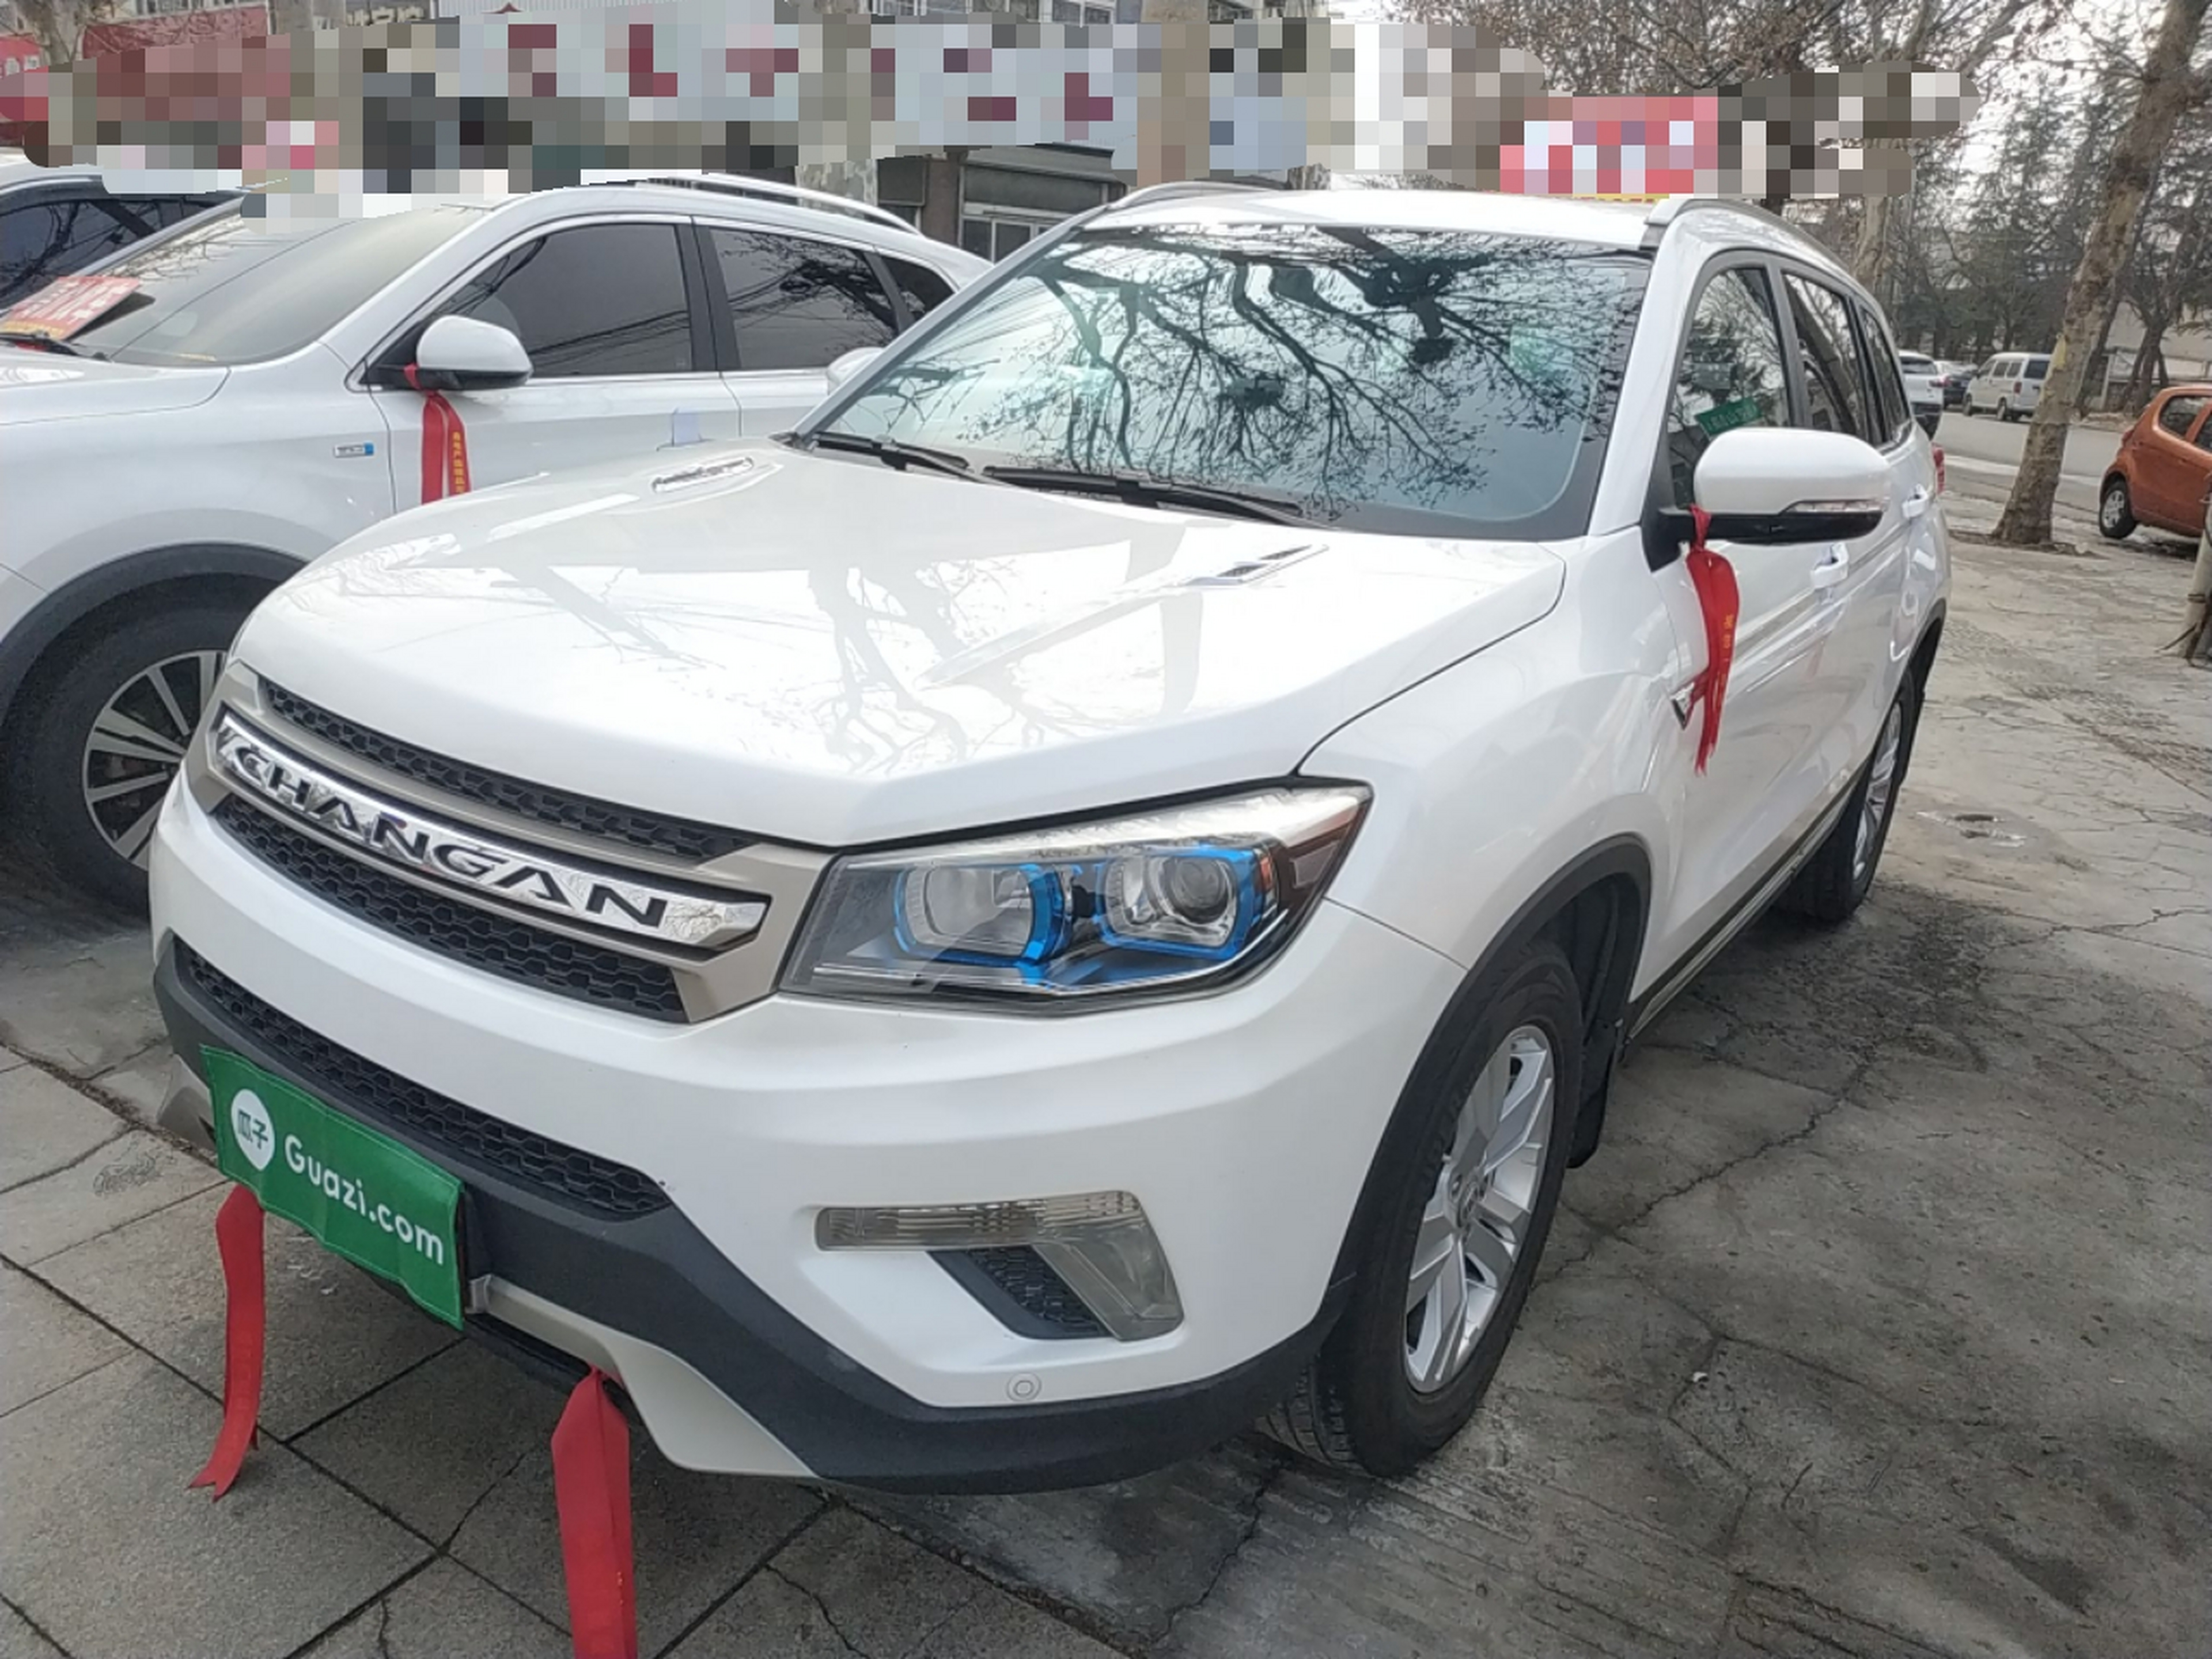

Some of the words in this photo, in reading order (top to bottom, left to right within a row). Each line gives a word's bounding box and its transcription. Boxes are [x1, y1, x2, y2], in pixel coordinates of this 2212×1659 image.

[234, 745, 668, 929] CHANGAN
[237, 1108, 269, 1150] 瓜子
[285, 1135, 443, 1265] Guazi.com
